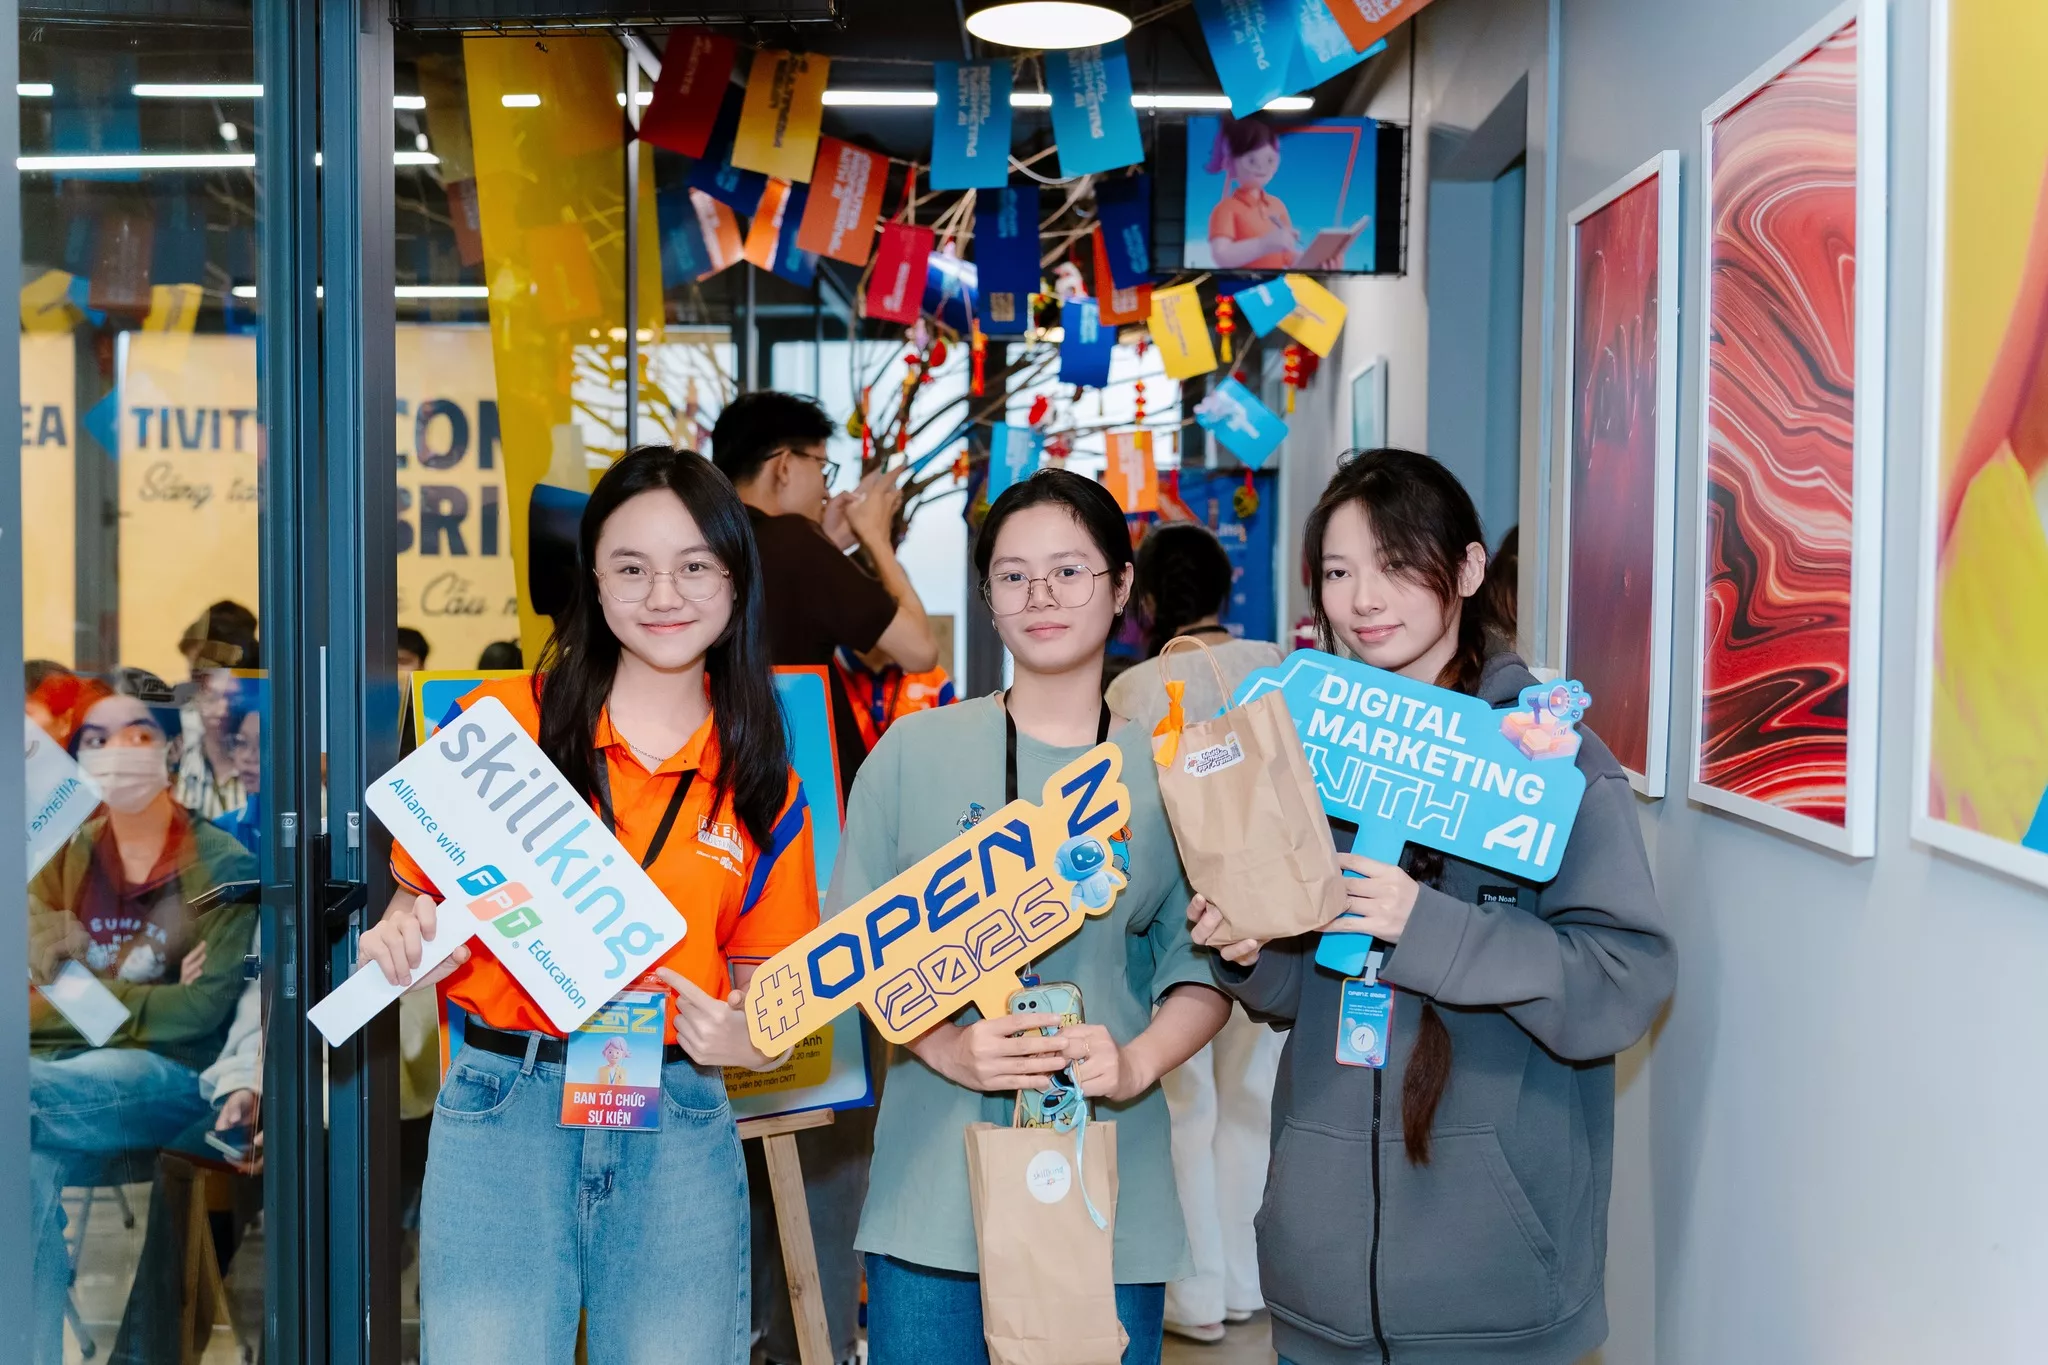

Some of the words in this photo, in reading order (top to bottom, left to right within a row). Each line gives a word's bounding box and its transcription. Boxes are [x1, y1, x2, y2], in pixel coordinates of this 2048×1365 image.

[129, 407, 258, 451] TIVIT
[1319, 673, 1468, 745] DIGITAL
[1307, 708, 1546, 806] MARKETING
[1060, 758, 1120, 838] Z
[1302, 741, 1470, 841] WITH
[1482, 813, 1557, 868] AI
[439, 722, 665, 980] skillking
[389, 777, 438, 834] Alliance
[435, 831, 466, 867] with
[459, 866, 540, 936] FPT
[527, 939, 587, 1011] Education
[1482, 893, 1498, 902] The
[1498, 895, 1517, 904] Noah
[874, 877, 1070, 1033] 2026
[779, 1073, 797, 1083] CNTT
[796, 1051, 805, 1060] 20
[573, 1091, 596, 1105] BAN
[599, 1090, 613, 1106] TỔ
[615, 1091, 646, 1108] CHỨC
[587, 1110, 605, 1127] SỰ
[606, 1109, 632, 1126] KIỆN
